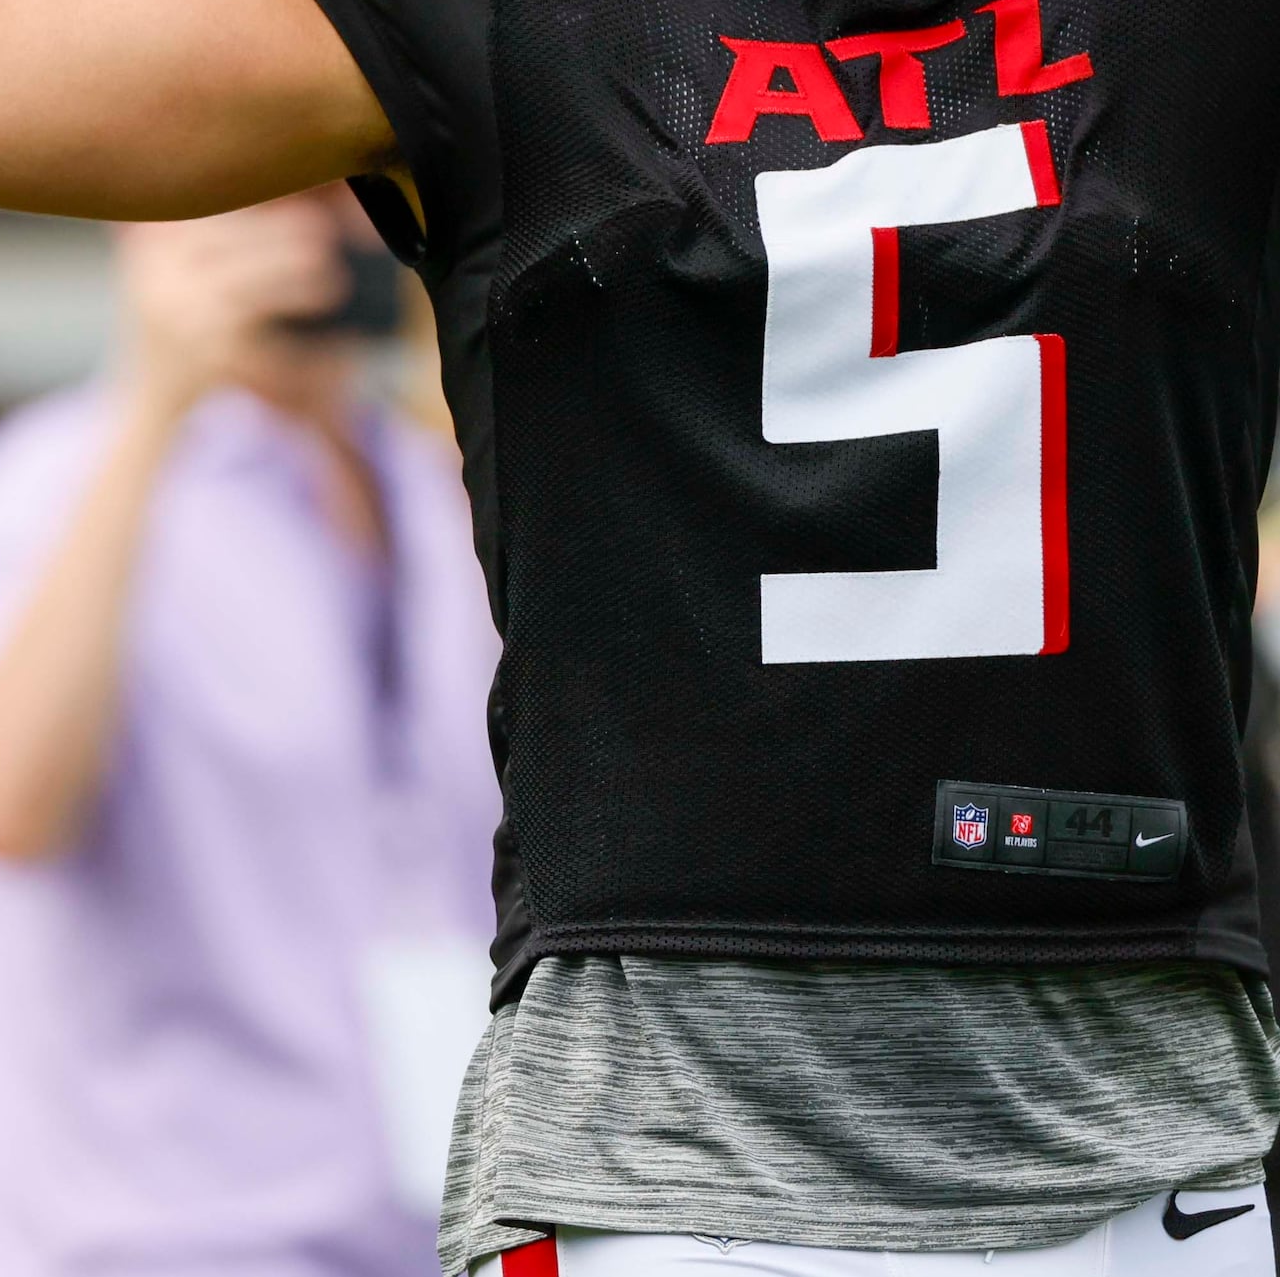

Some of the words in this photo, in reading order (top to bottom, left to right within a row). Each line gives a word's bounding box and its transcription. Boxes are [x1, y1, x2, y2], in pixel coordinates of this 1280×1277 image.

[754, 120, 1070, 664] 5
[958, 822, 982, 842] NFL
[1064, 807, 1113, 838] 44
[1004, 835, 1014, 846] NFL
[1014, 836, 1038, 848] PLAYERS
